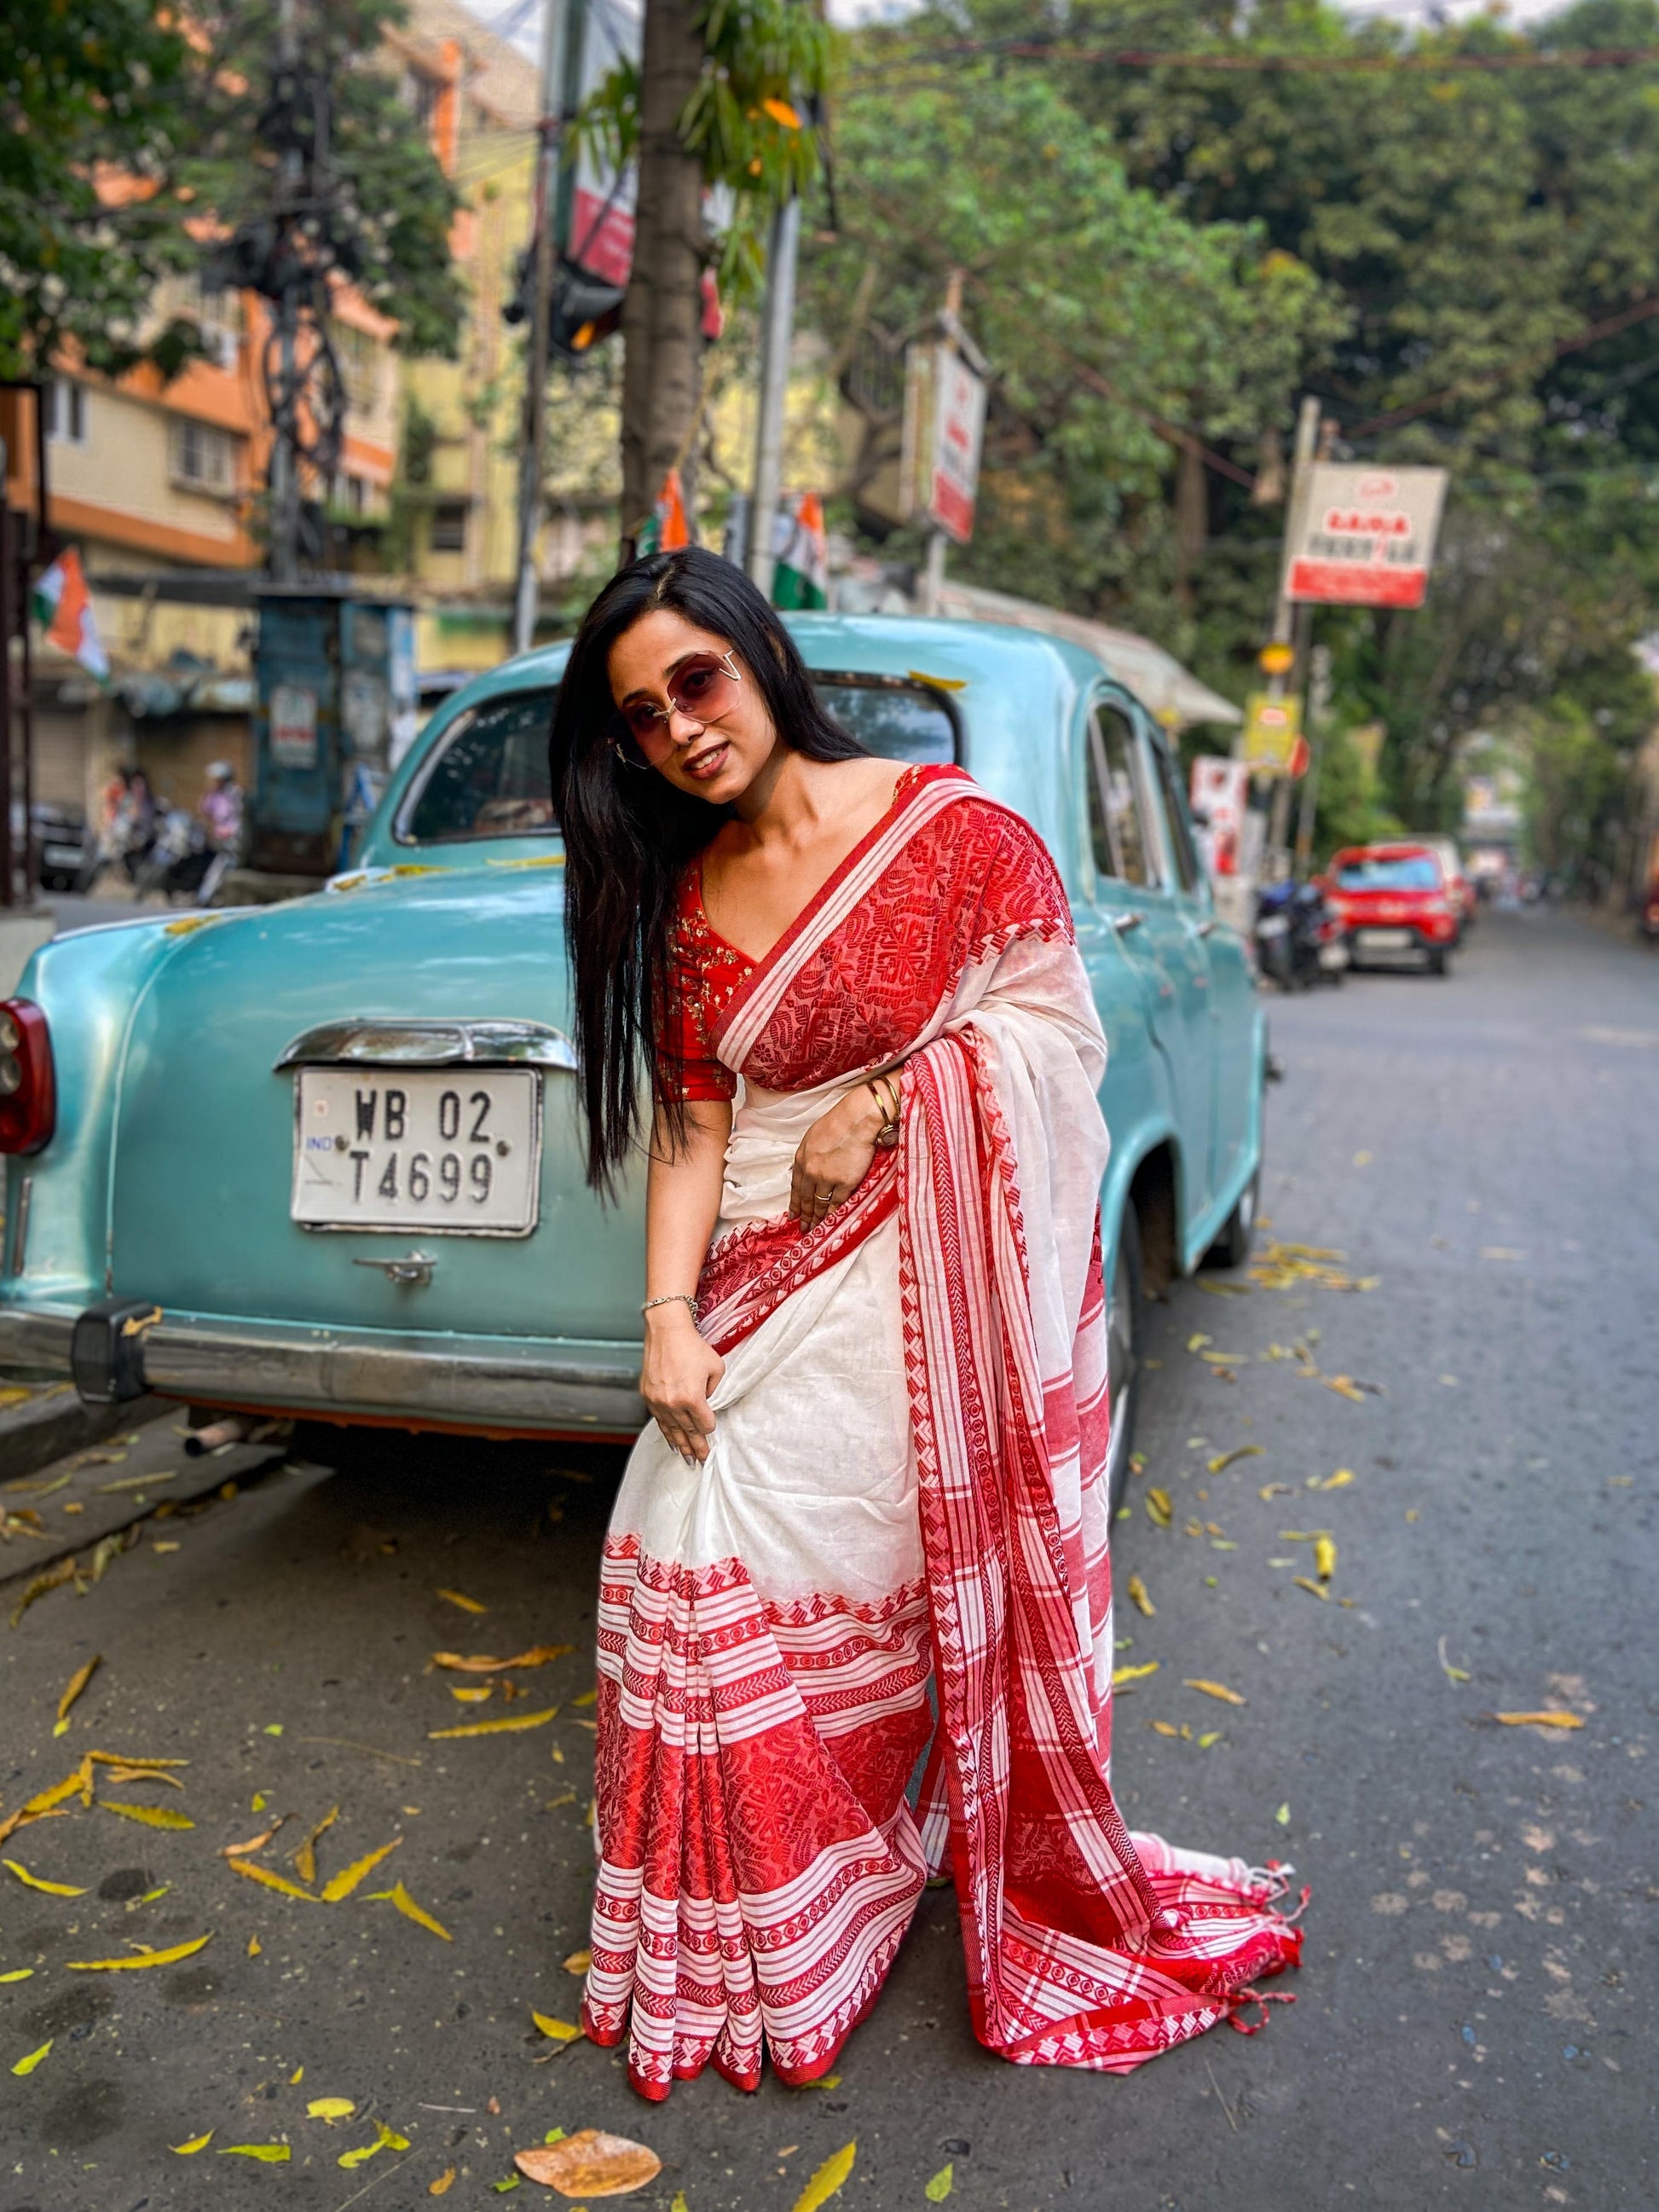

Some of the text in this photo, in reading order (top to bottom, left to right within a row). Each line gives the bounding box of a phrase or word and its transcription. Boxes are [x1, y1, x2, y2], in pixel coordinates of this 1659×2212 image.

[355, 1090, 492, 1143] WB 02
[306, 1137, 333, 1151] IND
[350, 1149, 493, 1203] T4699
